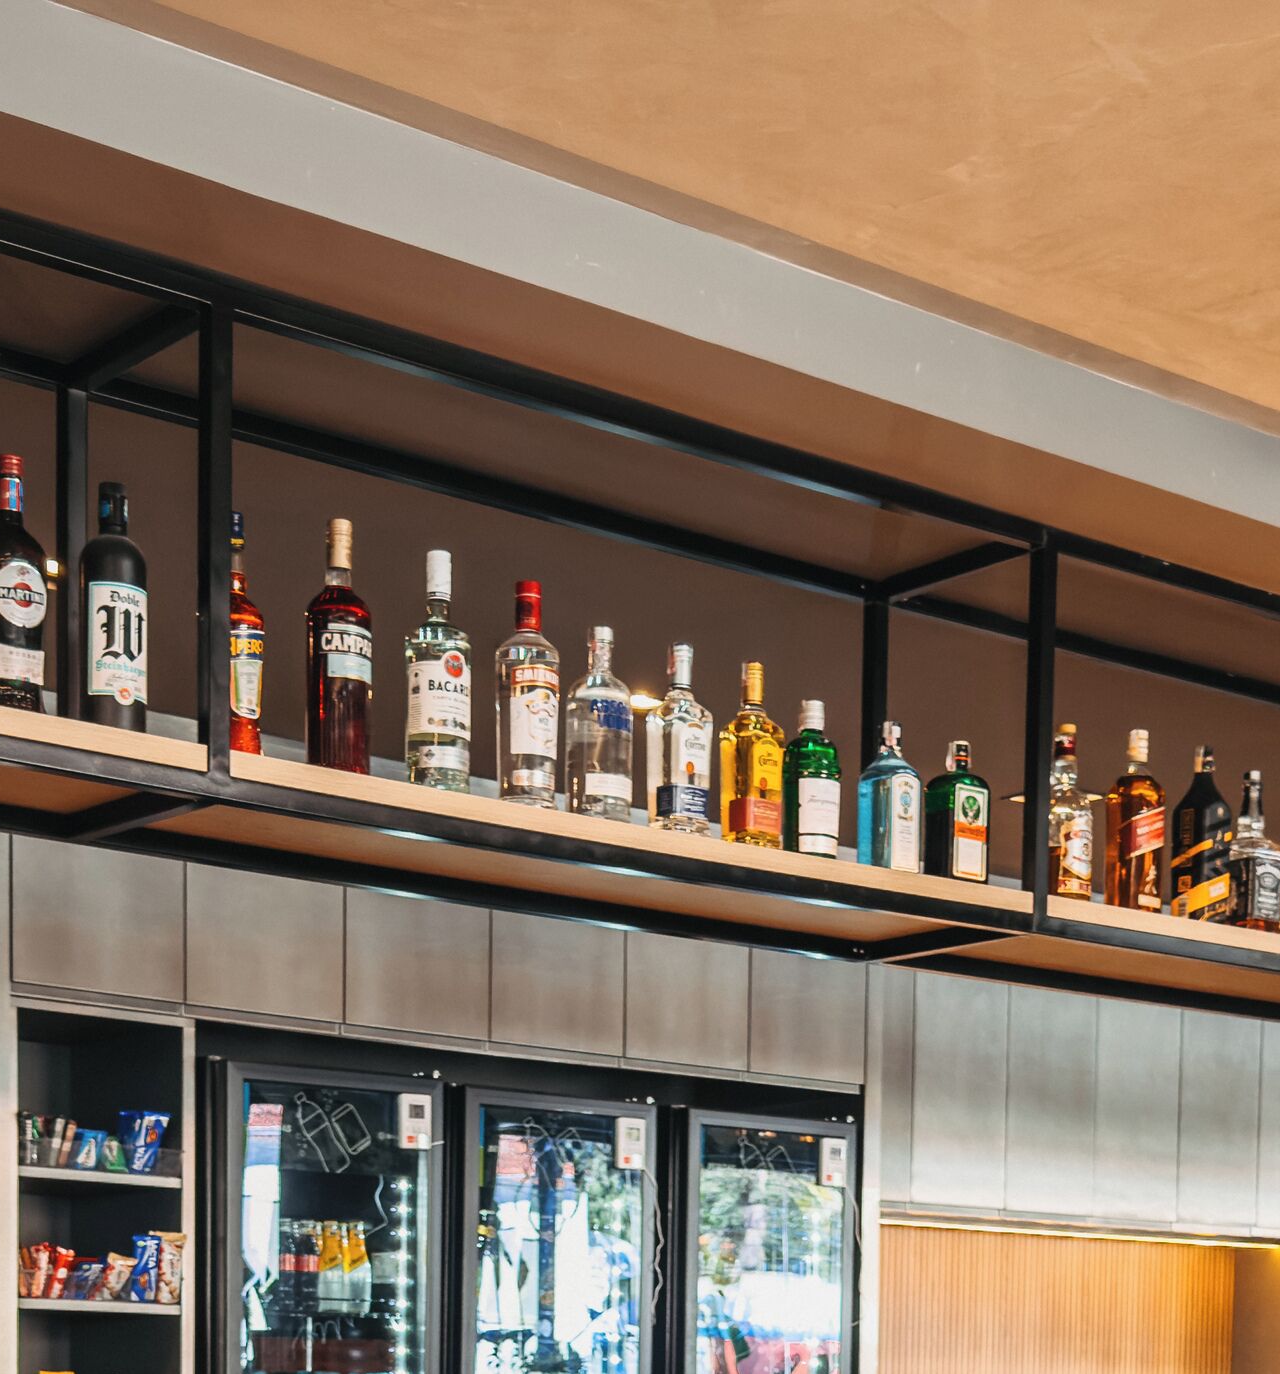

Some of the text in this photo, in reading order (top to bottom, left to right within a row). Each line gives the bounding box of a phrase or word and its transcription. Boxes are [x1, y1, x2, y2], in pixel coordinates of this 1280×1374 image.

[230, 636, 264, 656] PERO
[321, 632, 372, 658] CAMPA
[428, 679, 469, 698] BACARD
